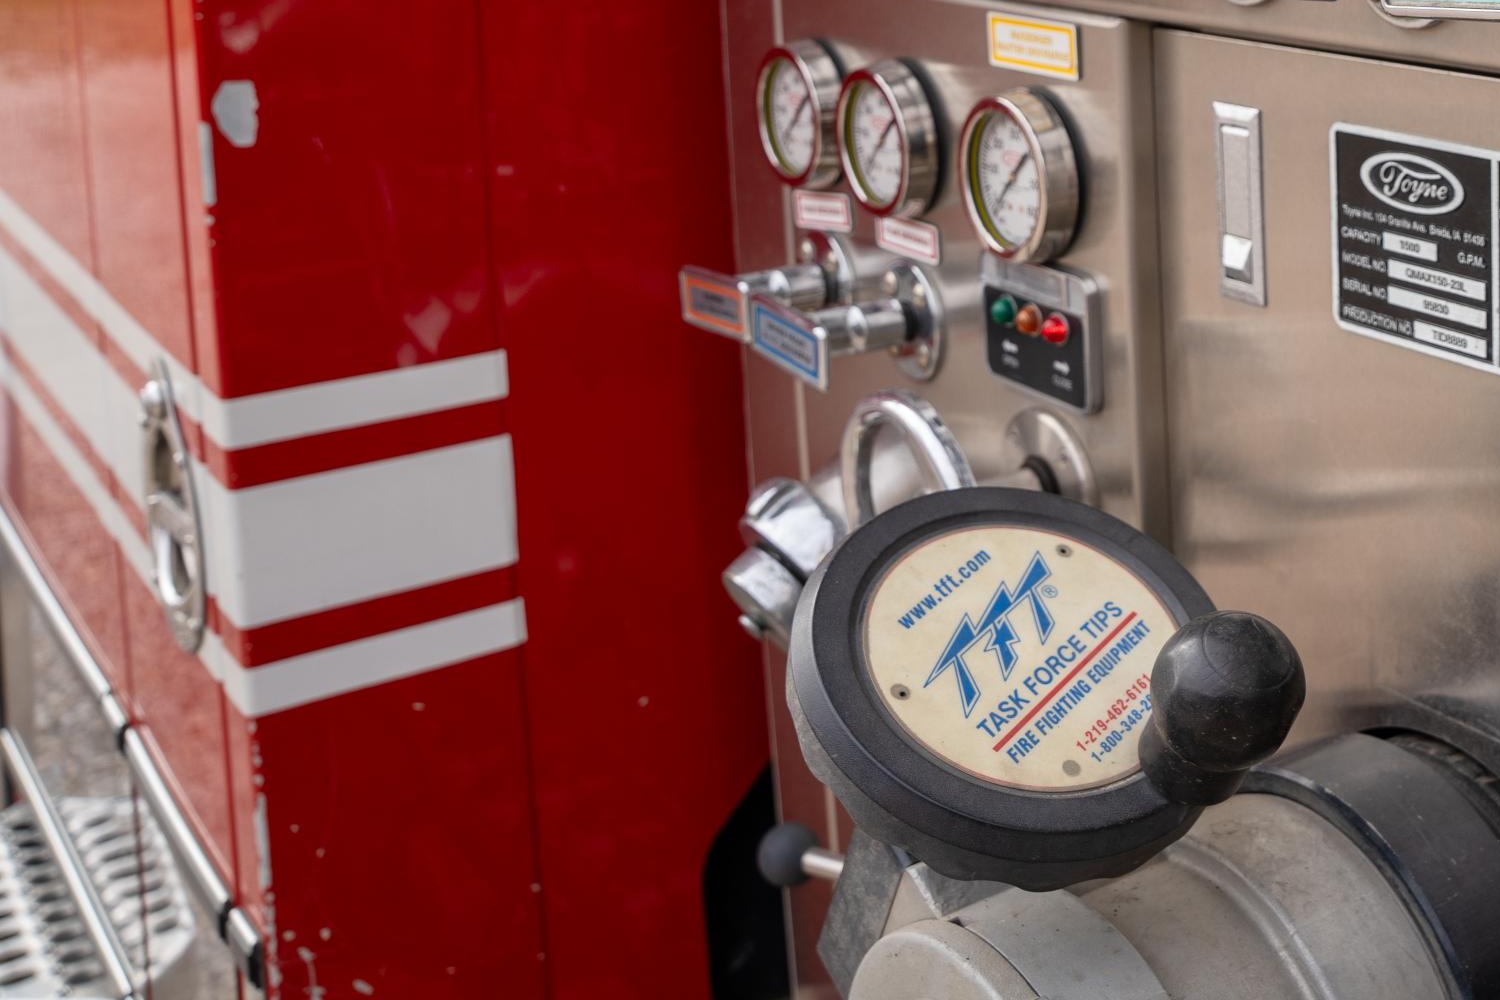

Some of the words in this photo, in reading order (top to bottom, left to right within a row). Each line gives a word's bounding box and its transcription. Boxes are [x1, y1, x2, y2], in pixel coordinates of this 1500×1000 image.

[1379, 160, 1449, 203] Toyne
[1342, 252, 1371, 269] MODEL
[1342, 306, 1397, 329] PRODUCTION
[897, 549, 992, 630] www.tft.com
[975, 688, 1031, 739] TASK
[1022, 634, 1088, 696] FORCE
[1080, 601, 1123, 639] TIPS
[1006, 730, 1041, 764] FIRE
[1034, 679, 1092, 736] FIGHTING
[1086, 619, 1150, 685] EQUIPMENT
[1075, 673, 1152, 752] 1-219-462-6161
